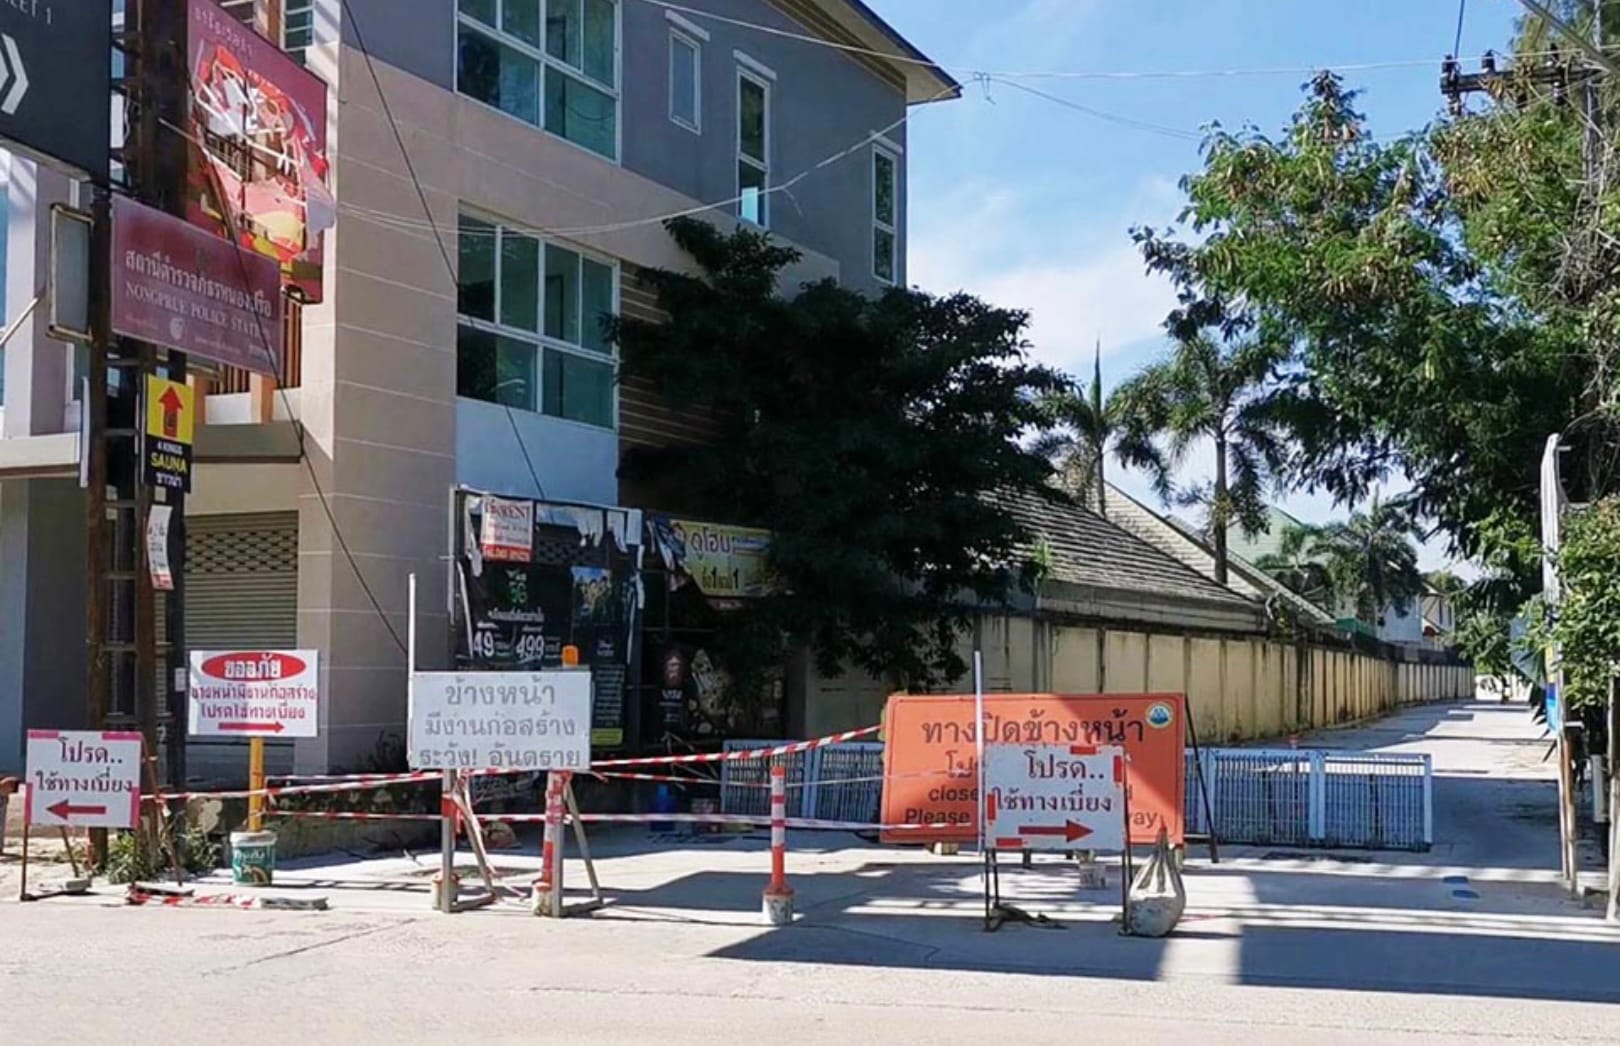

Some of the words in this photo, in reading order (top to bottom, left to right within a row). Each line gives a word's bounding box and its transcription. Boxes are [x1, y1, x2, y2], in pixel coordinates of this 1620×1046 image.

[191, 302, 228, 325] POLICE
[150, 451, 188, 474] SAUNA
[515, 634, 545, 660] 499
[445, 675, 556, 705] ข้างหน้า
[425, 711, 576, 736] มีงานก่อสร้าง
[922, 709, 1144, 744] ทางปิดข้างหน้า
[488, 741, 581, 767] อันตราย
[35, 767, 133, 793] ใช้ทางเบี่ยง
[929, 784, 979, 802] close
[991, 783, 1113, 812] ใช้ทางเบี่ยง
[905, 808, 971, 824] Please
